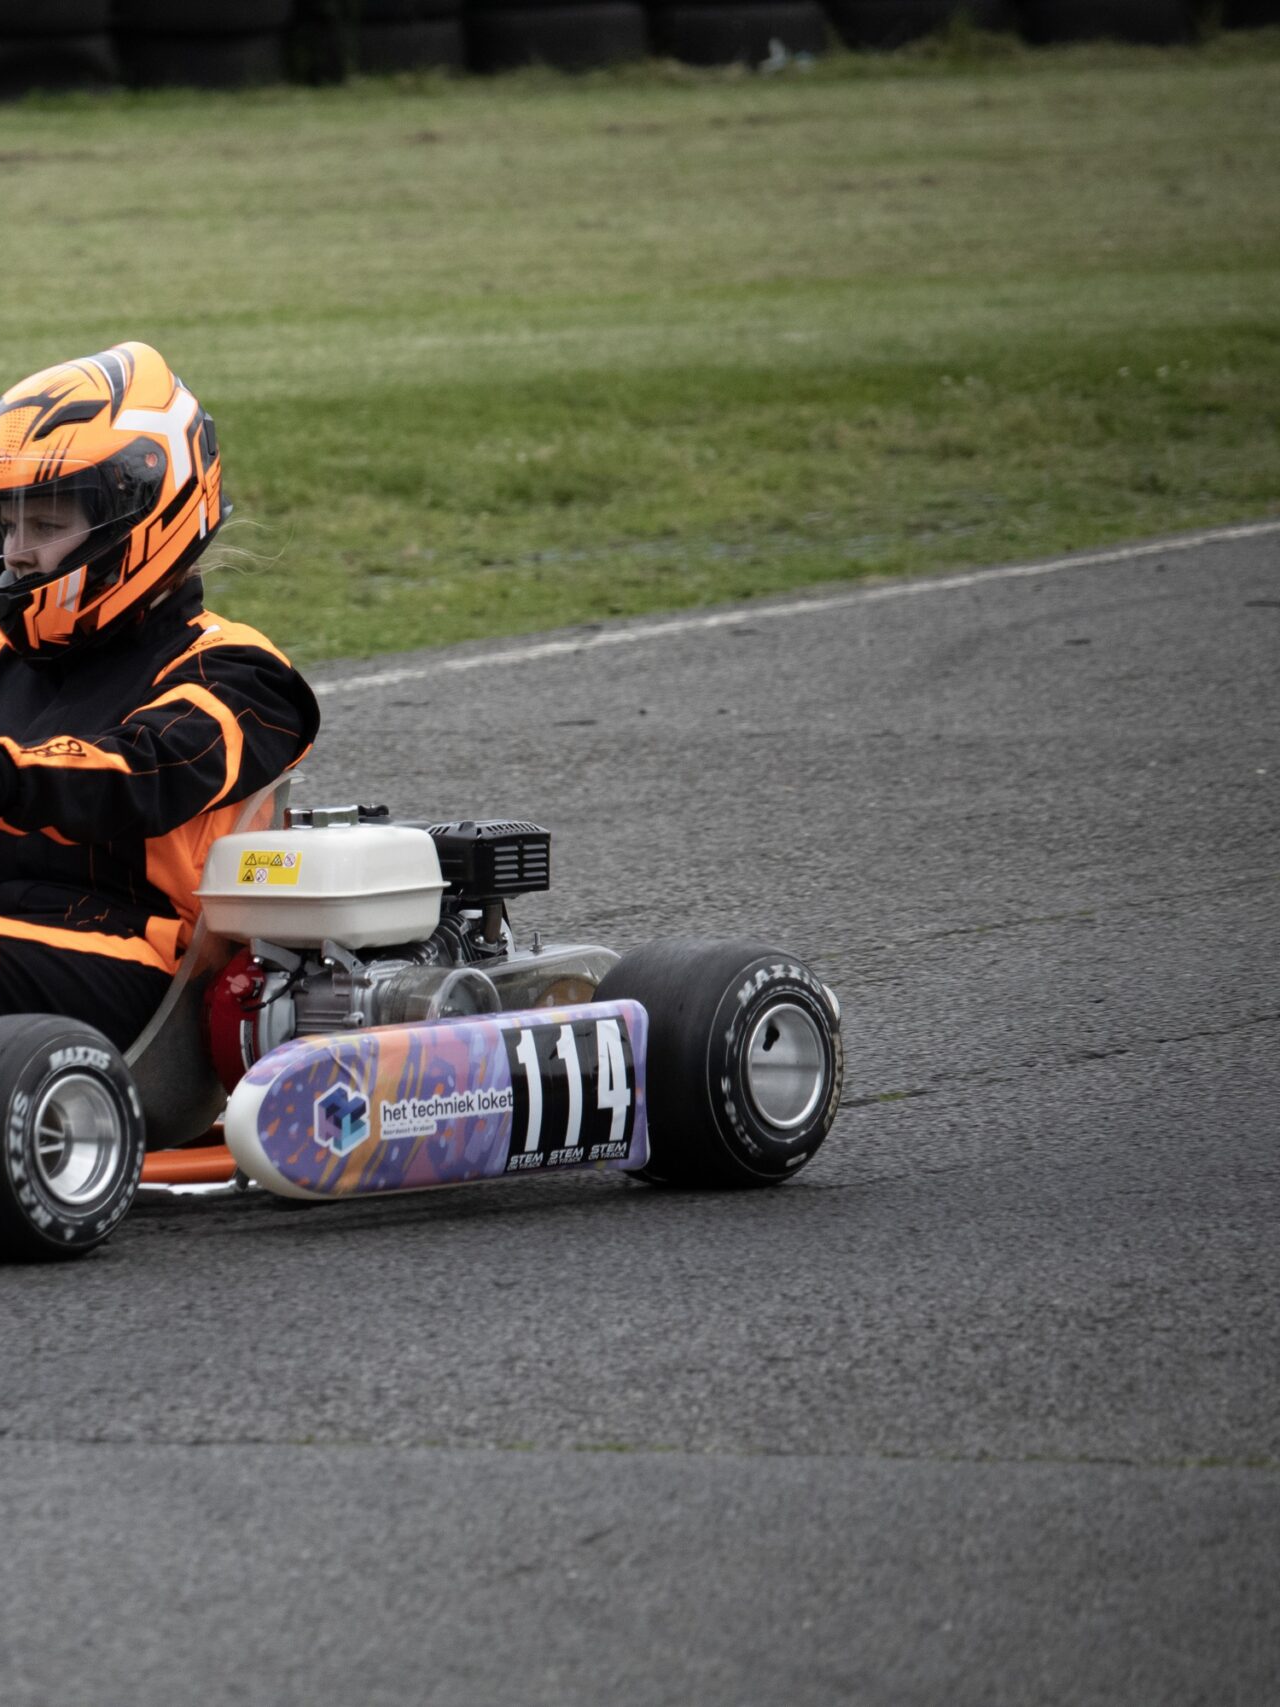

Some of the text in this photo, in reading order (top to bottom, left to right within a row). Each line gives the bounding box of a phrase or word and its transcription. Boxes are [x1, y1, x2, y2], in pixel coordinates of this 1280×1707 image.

[736, 963, 821, 1007] MAXXIS
[49, 1046, 111, 1071] MAXXIS
[516, 1019, 631, 1152] 114
[383, 1092, 514, 1122] het techniek loket
[8, 1090, 53, 1229] MAXXIS
[509, 1152, 544, 1165] STEM
[549, 1147, 585, 1161] STEM
[588, 1150, 625, 1161] ON TRACK
[591, 1141, 628, 1155] STEM
